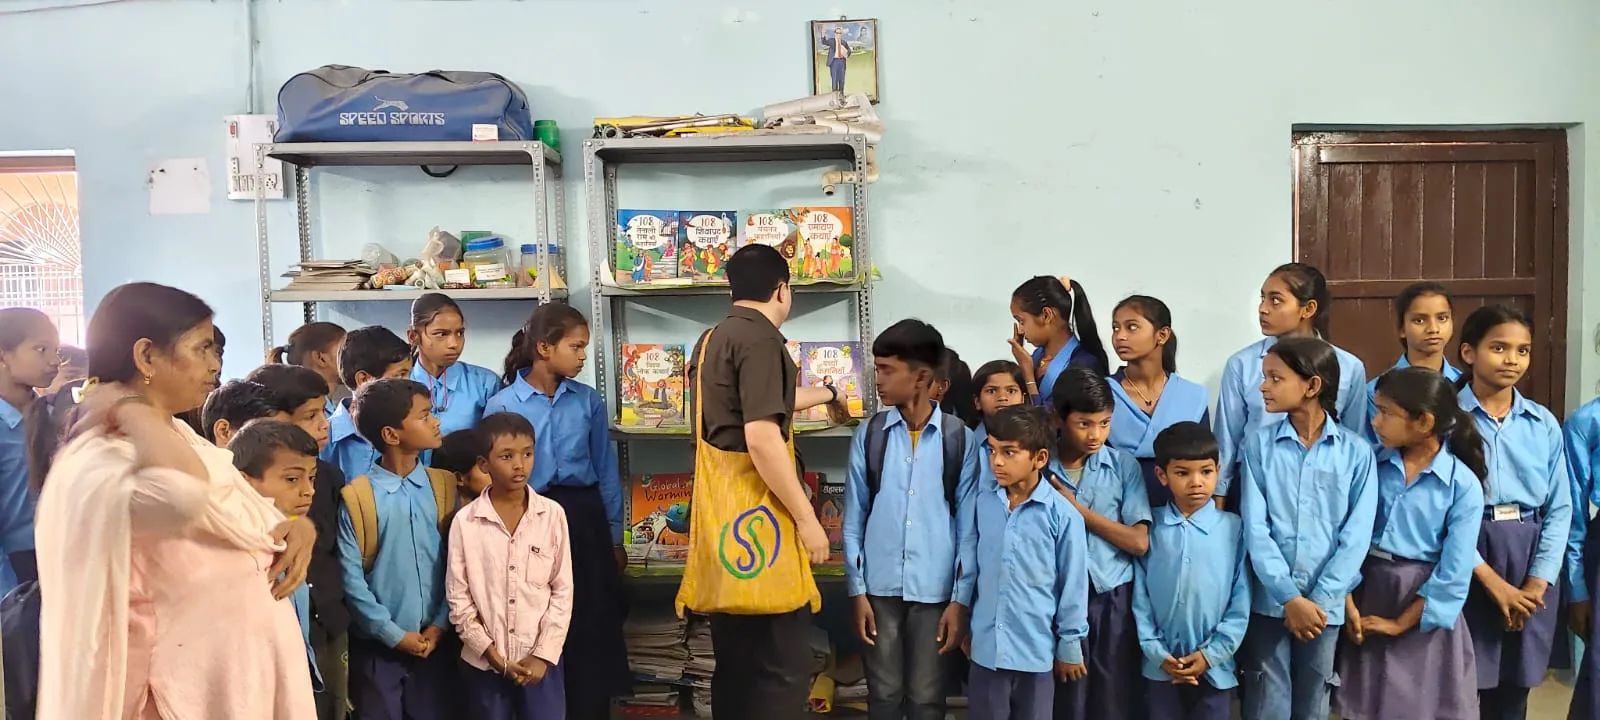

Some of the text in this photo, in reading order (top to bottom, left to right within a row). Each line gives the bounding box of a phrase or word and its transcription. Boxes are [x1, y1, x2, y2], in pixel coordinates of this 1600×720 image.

[339, 112, 446, 126] SPEED SPORTS
[639, 216, 654, 226] 108
[701, 217, 716, 227] 108
[759, 216, 774, 226] 108
[813, 213, 828, 223] 108
[646, 352, 660, 361] 108
[823, 349, 838, 359] 108
[650, 477, 681, 490] Global
[645, 489, 691, 502] Warmin
